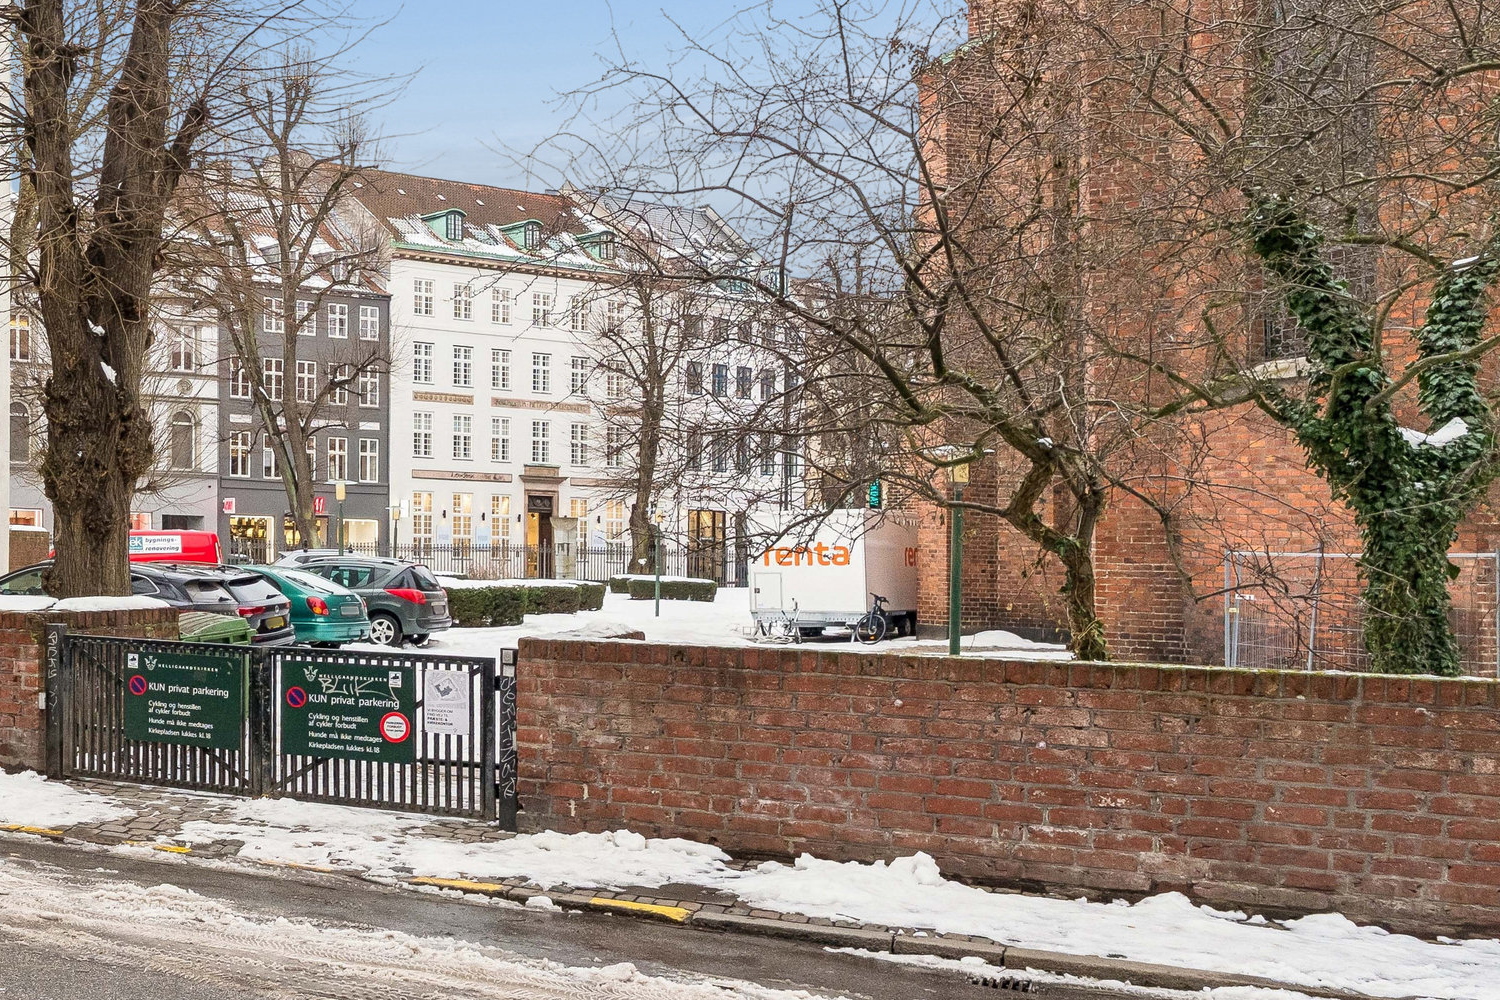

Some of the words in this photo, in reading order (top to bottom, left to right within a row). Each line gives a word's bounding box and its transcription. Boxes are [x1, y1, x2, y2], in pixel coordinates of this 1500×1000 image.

[764, 542, 850, 566] renta
[148, 682, 165, 691] KUN
[168, 684, 190, 693] privat
[193, 686, 229, 698] parkering
[148, 700, 167, 708] Cykling
[308, 694, 327, 703] KUN
[331, 696, 355, 705] privat
[359, 698, 399, 710] parkering
[308, 713, 329, 721] Cykling
[342, 715, 368, 723] henstillen
[188, 721, 213, 729] medtages
[335, 721, 356, 729] forbudt
[148, 728, 180, 736] Kirkepladsen
[329, 731, 338, 739] må
[354, 734, 382, 743] medtages
[308, 742, 344, 751] Kirkepladsen
[346, 744, 364, 752] lukkes
